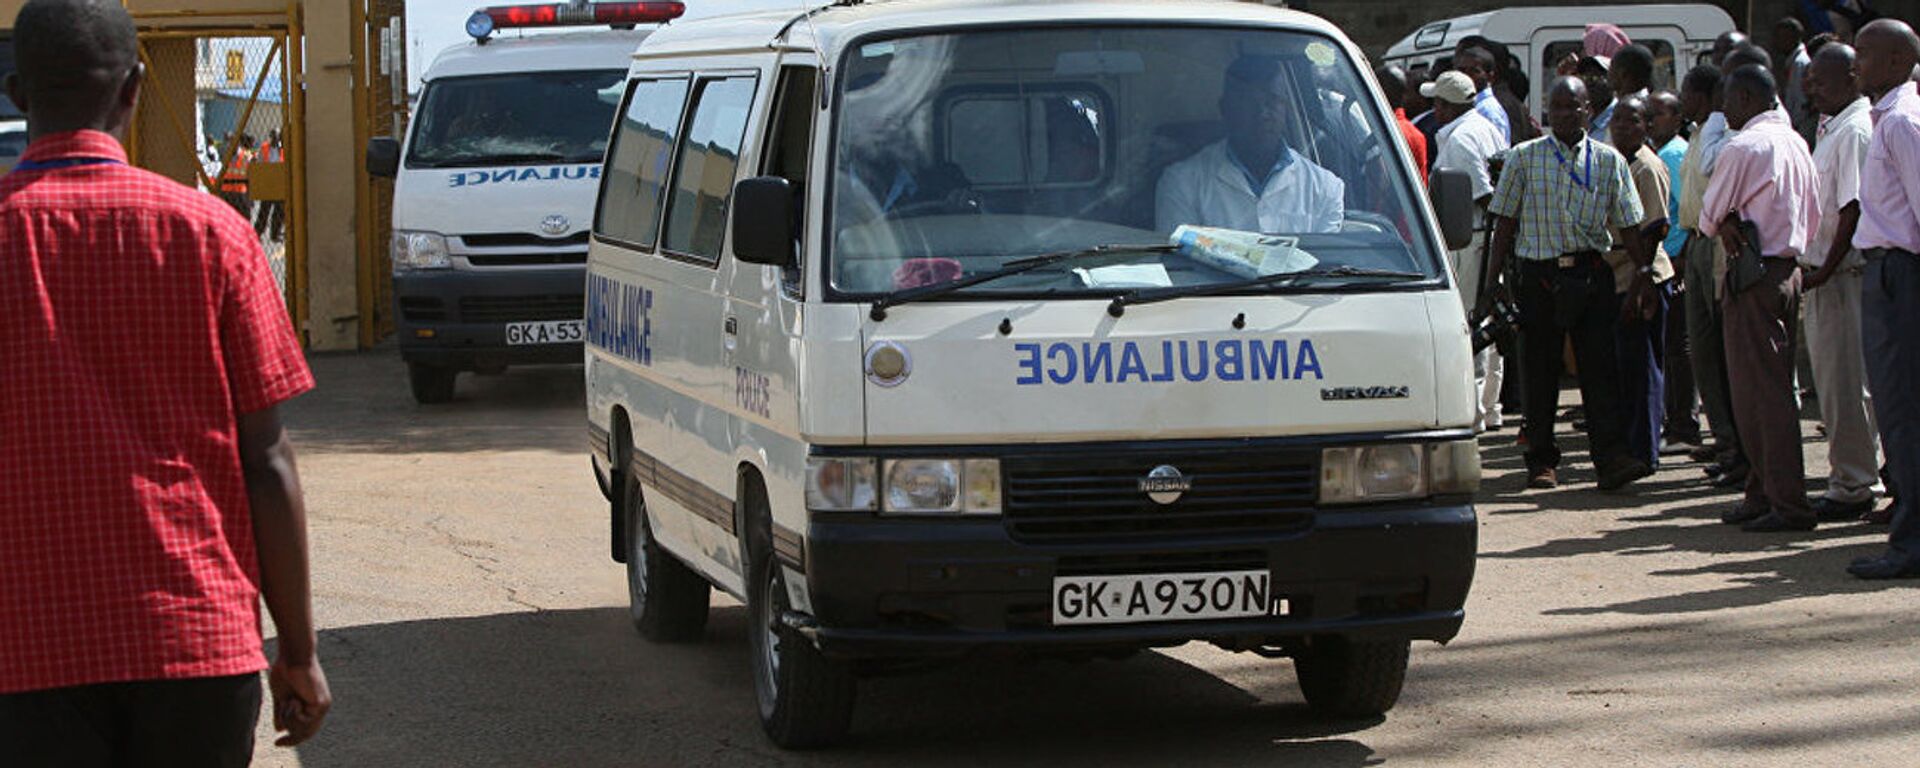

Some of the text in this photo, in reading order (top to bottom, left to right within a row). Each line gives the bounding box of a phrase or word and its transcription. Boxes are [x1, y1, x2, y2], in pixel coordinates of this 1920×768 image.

[557, 323, 584, 340] 53
[587, 272, 653, 366] AMBULANCE
[736, 366, 770, 419] POLICE
[1138, 480, 1191, 492] NISSAN
